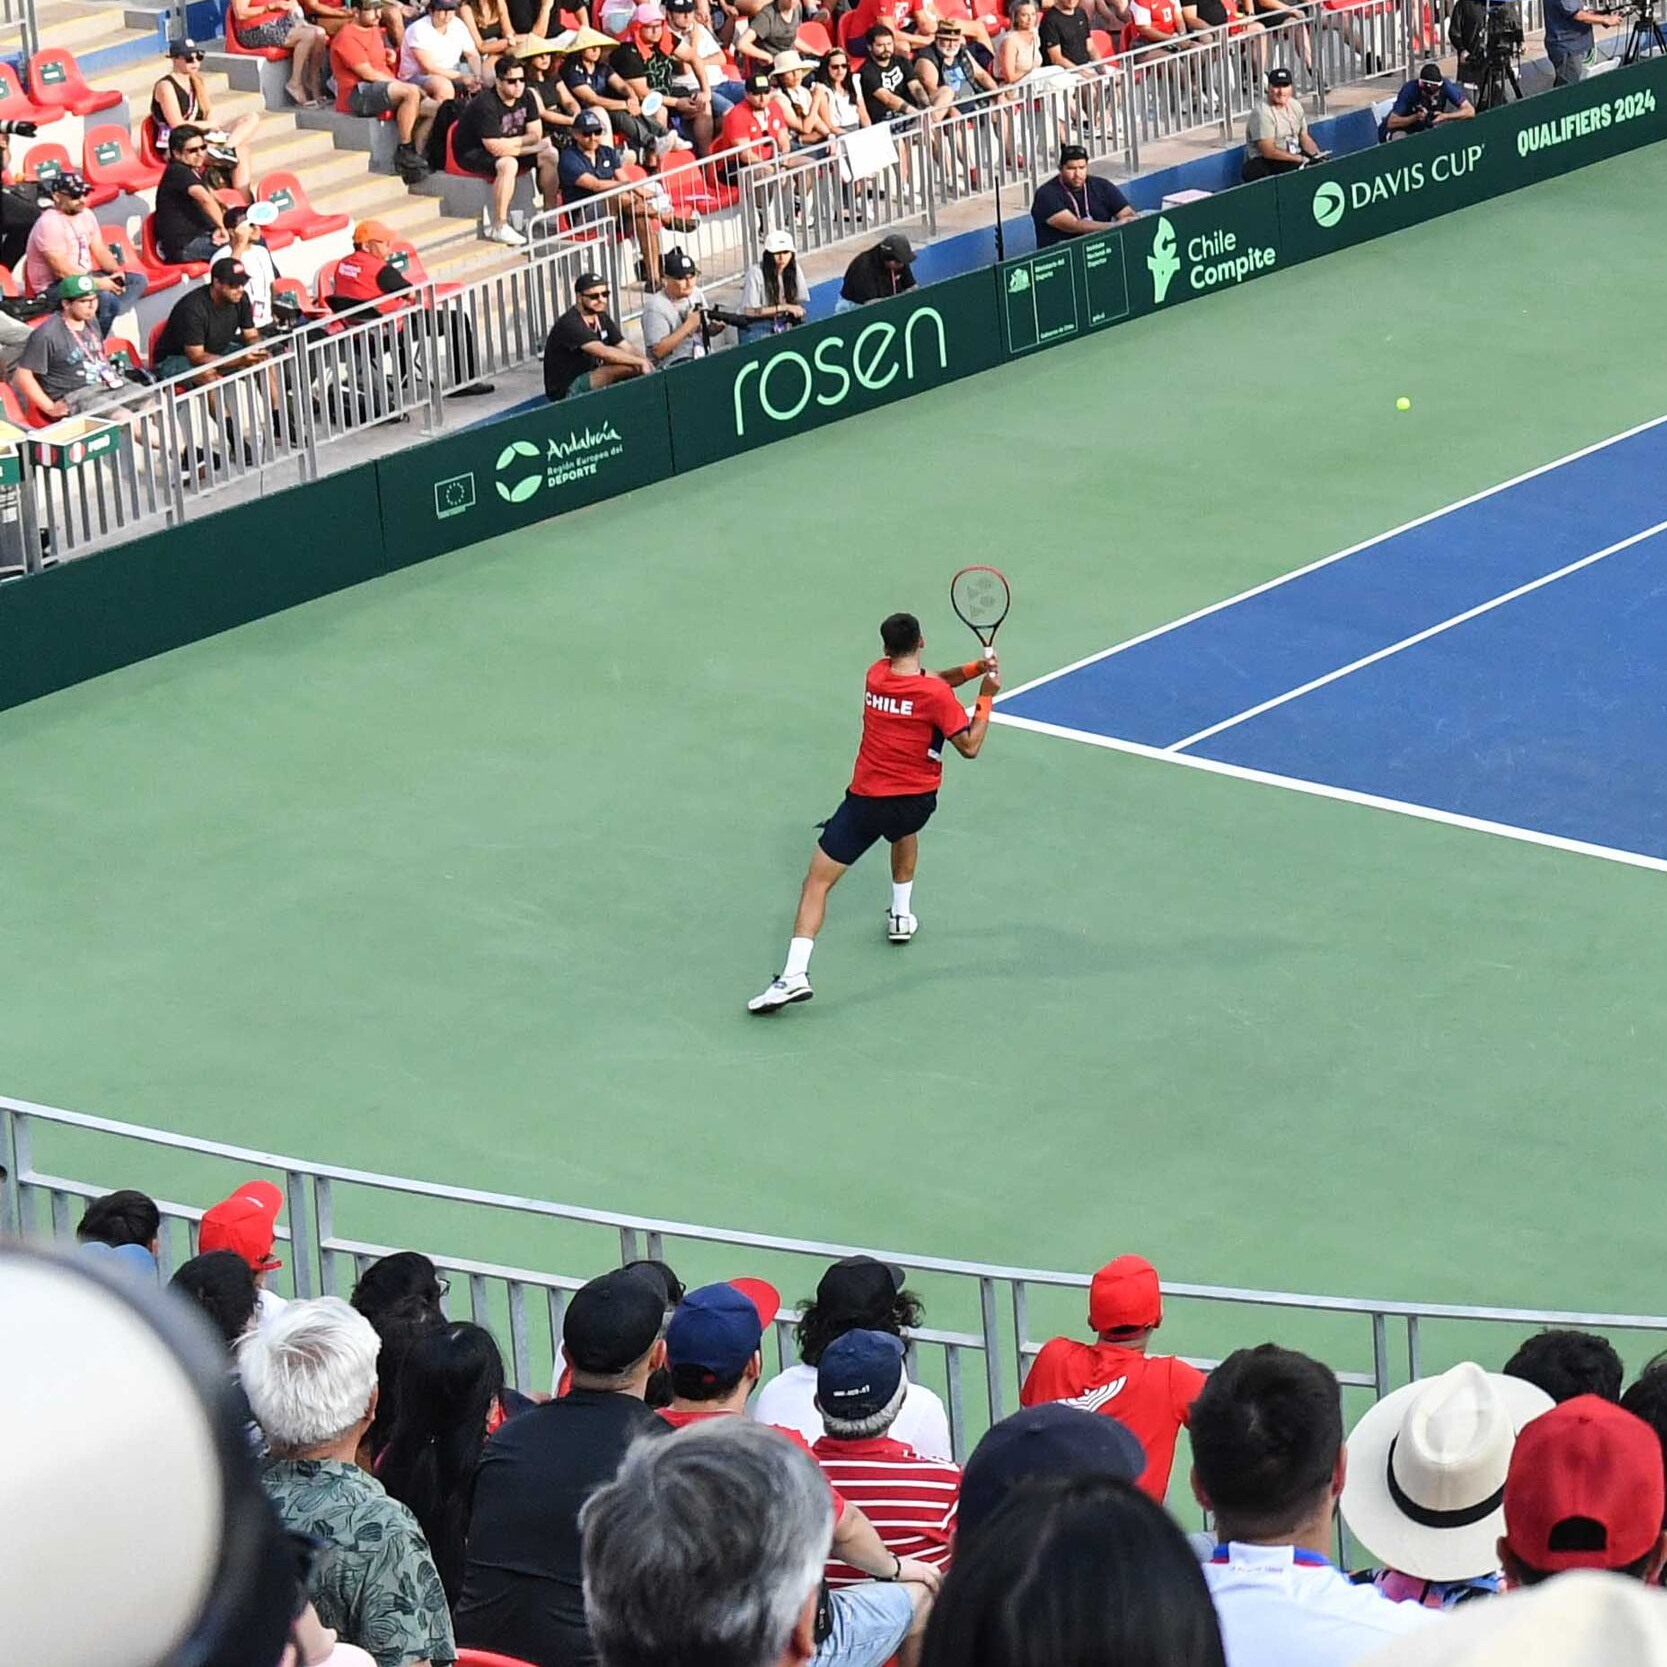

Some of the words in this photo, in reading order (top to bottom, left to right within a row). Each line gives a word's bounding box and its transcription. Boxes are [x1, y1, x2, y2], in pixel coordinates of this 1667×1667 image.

[1517, 106, 1613, 158] QUALIFIERS
[1613, 89, 1657, 125] 2024
[1351, 161, 1426, 211] DAVIS
[1187, 229, 1237, 263] Chile
[1190, 245, 1278, 291] Compite
[733, 306, 947, 437] rosen
[546, 420, 623, 461] Andalucía
[547, 463, 598, 488] DEPORTE
[864, 689, 914, 717] CHILE
